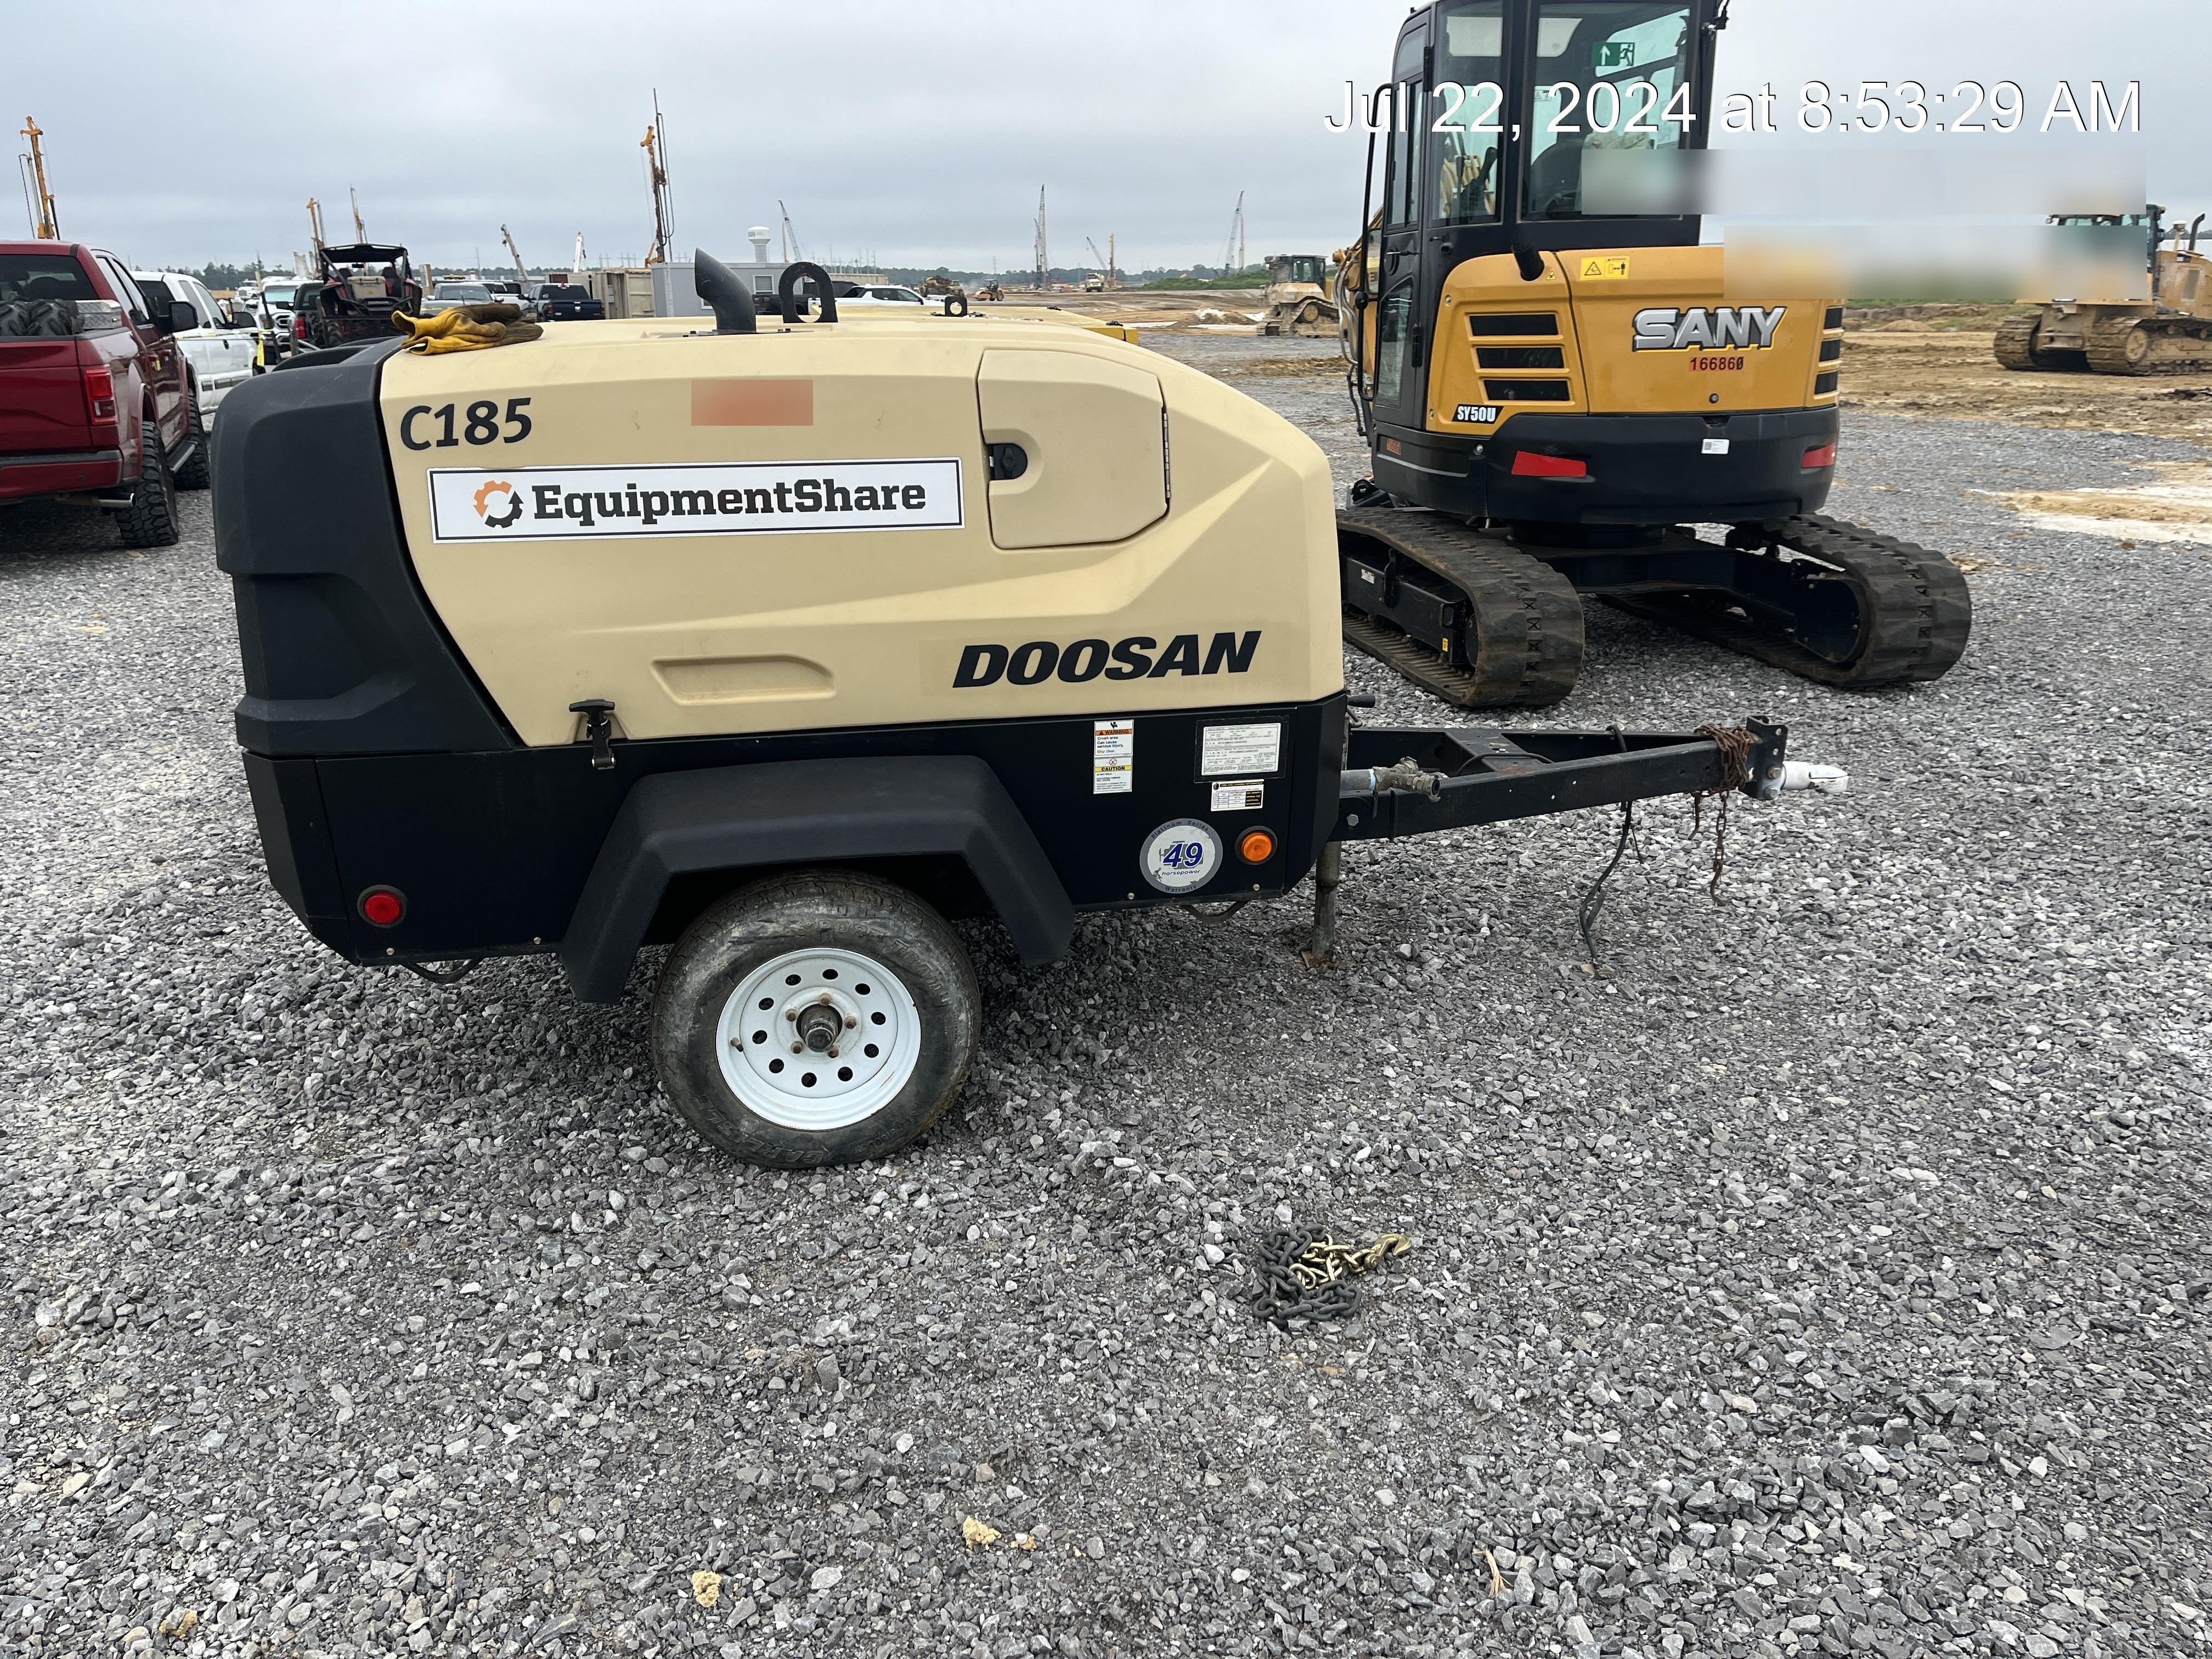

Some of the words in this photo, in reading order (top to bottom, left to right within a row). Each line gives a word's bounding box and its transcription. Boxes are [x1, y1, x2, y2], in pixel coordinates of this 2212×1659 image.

[1633, 307, 1787, 351] SANY
[1690, 356, 1744, 370] 166860
[400, 397, 532, 450] C185
[1457, 406, 1496, 422] SY50U
[532, 478, 926, 527] EquipmentShare
[952, 630, 1262, 689] DOOSAN
[1151, 821, 1182, 839] Platinum
[1187, 820, 1209, 831] Series
[1163, 842, 1204, 868] 49
[1165, 884, 1197, 893] Warranty
